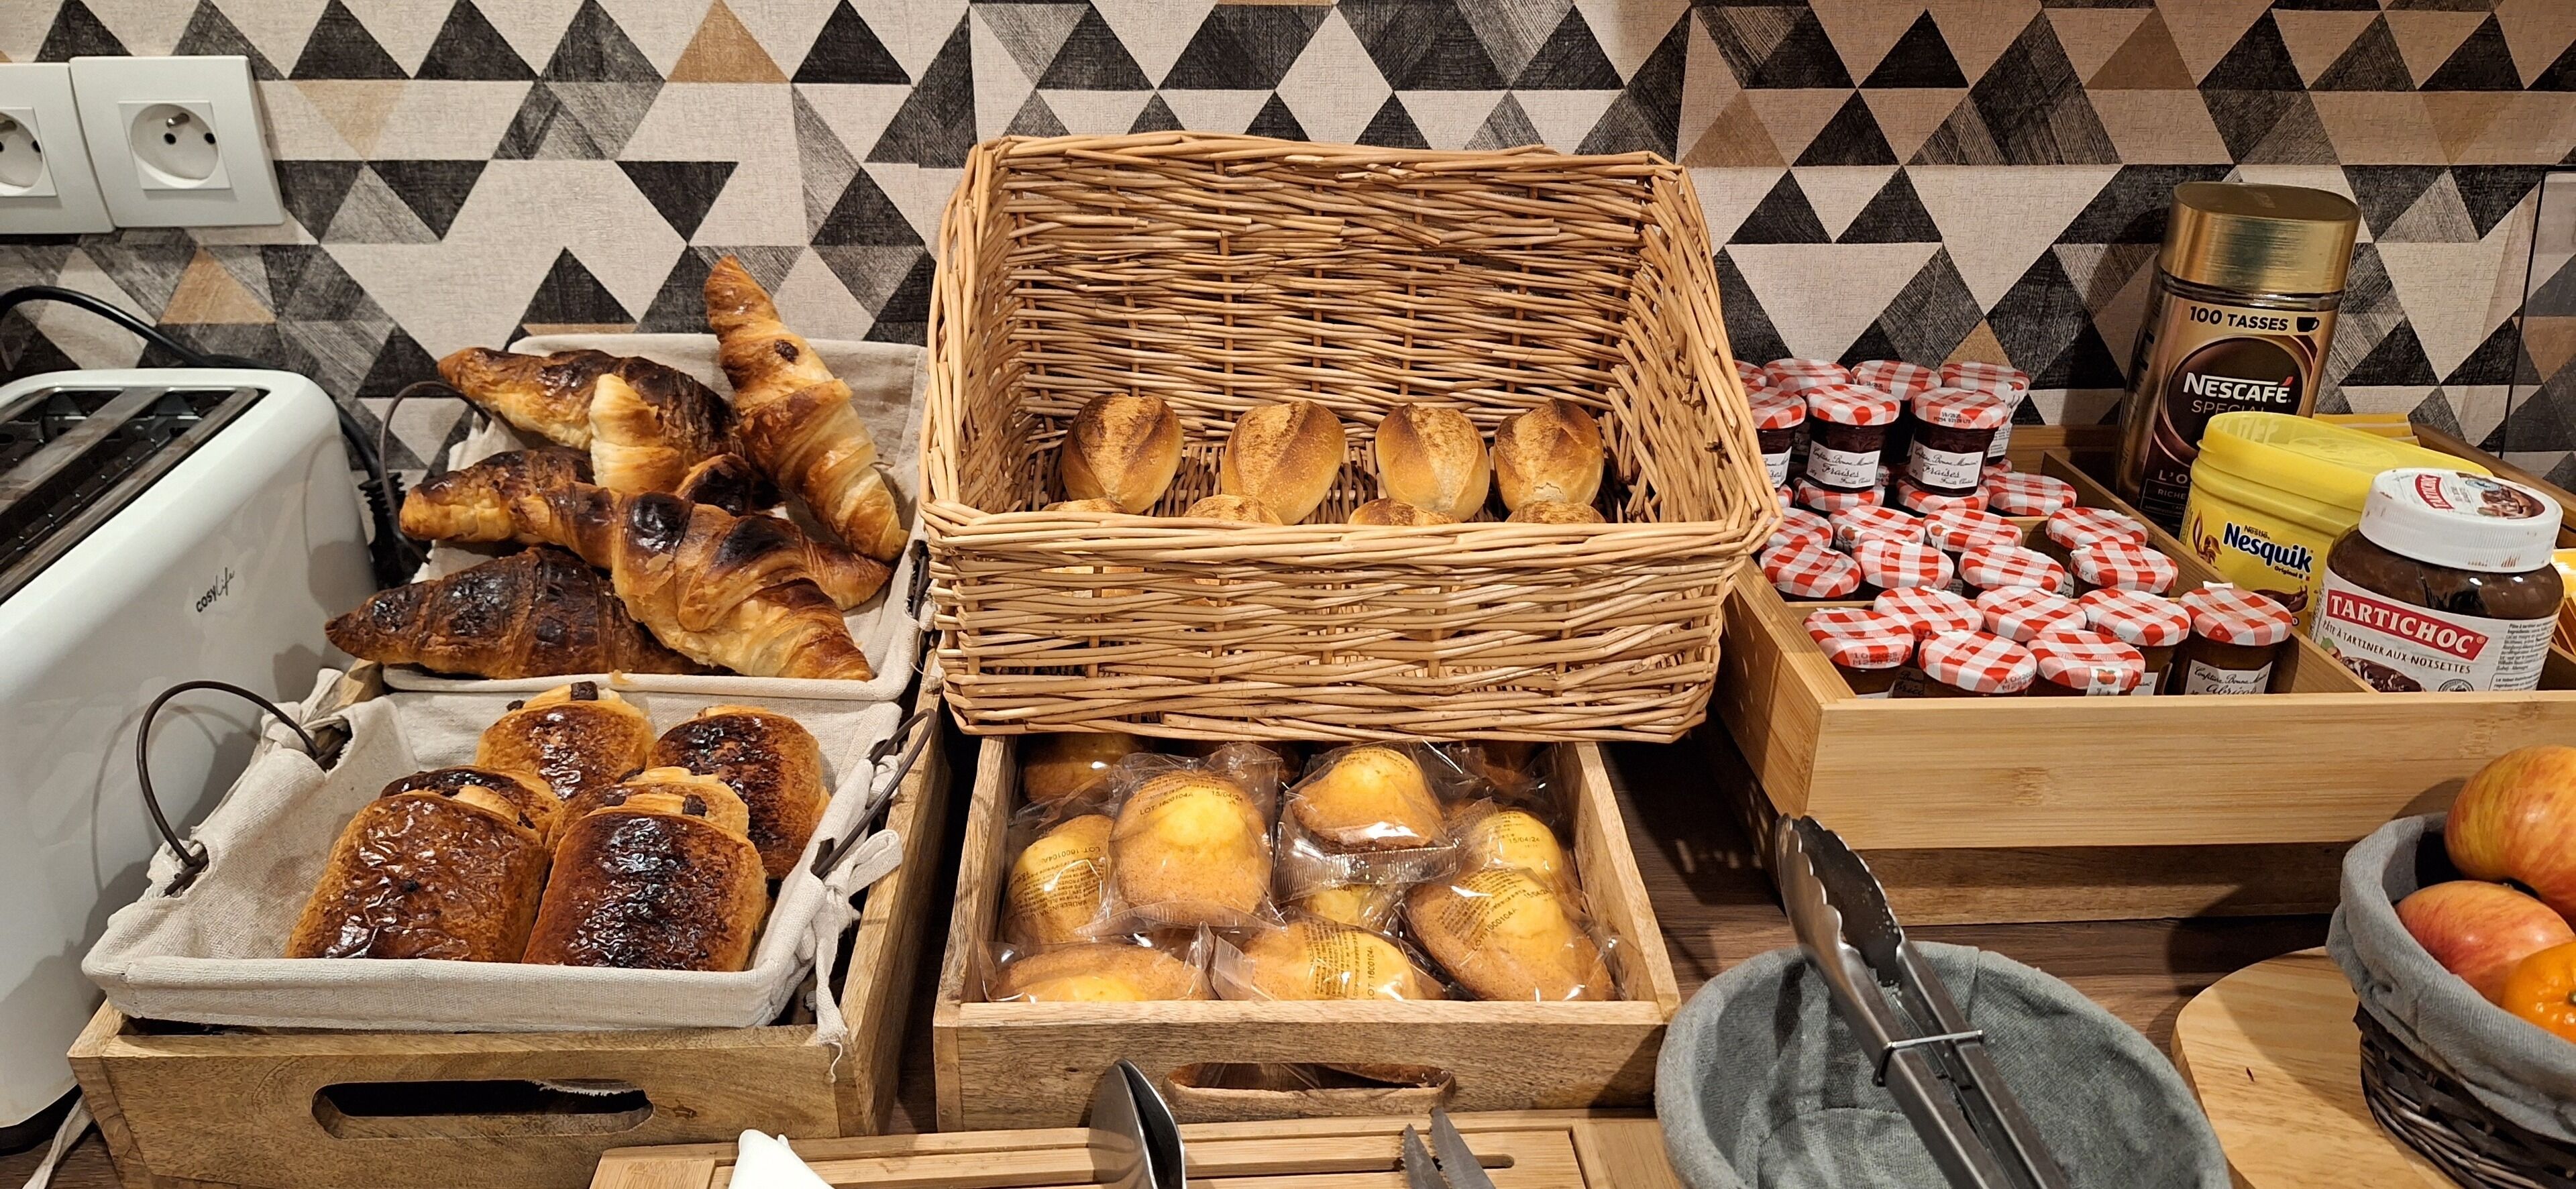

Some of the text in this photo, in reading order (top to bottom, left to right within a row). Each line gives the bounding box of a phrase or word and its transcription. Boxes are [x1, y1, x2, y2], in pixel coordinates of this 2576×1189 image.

[2190, 306, 2289, 331] 100 TASSES
[2183, 372, 2294, 403] NESCAFÉ
[1821, 463, 1859, 478] Fraises
[1922, 463, 1961, 478] Fraises
[2158, 488, 2187, 500] RICHE
[2244, 525, 2267, 538] Nestlé
[2223, 522, 2312, 573] Nesquik
[2274, 565, 2298, 577] Original
[2331, 596, 2474, 654] TARTICHOC
[2322, 620, 2471, 674] PÂTE À TARTINER AUX NOISETTES
[2194, 666, 2222, 683] Confiture
[2226, 673, 2249, 684] Bonne
